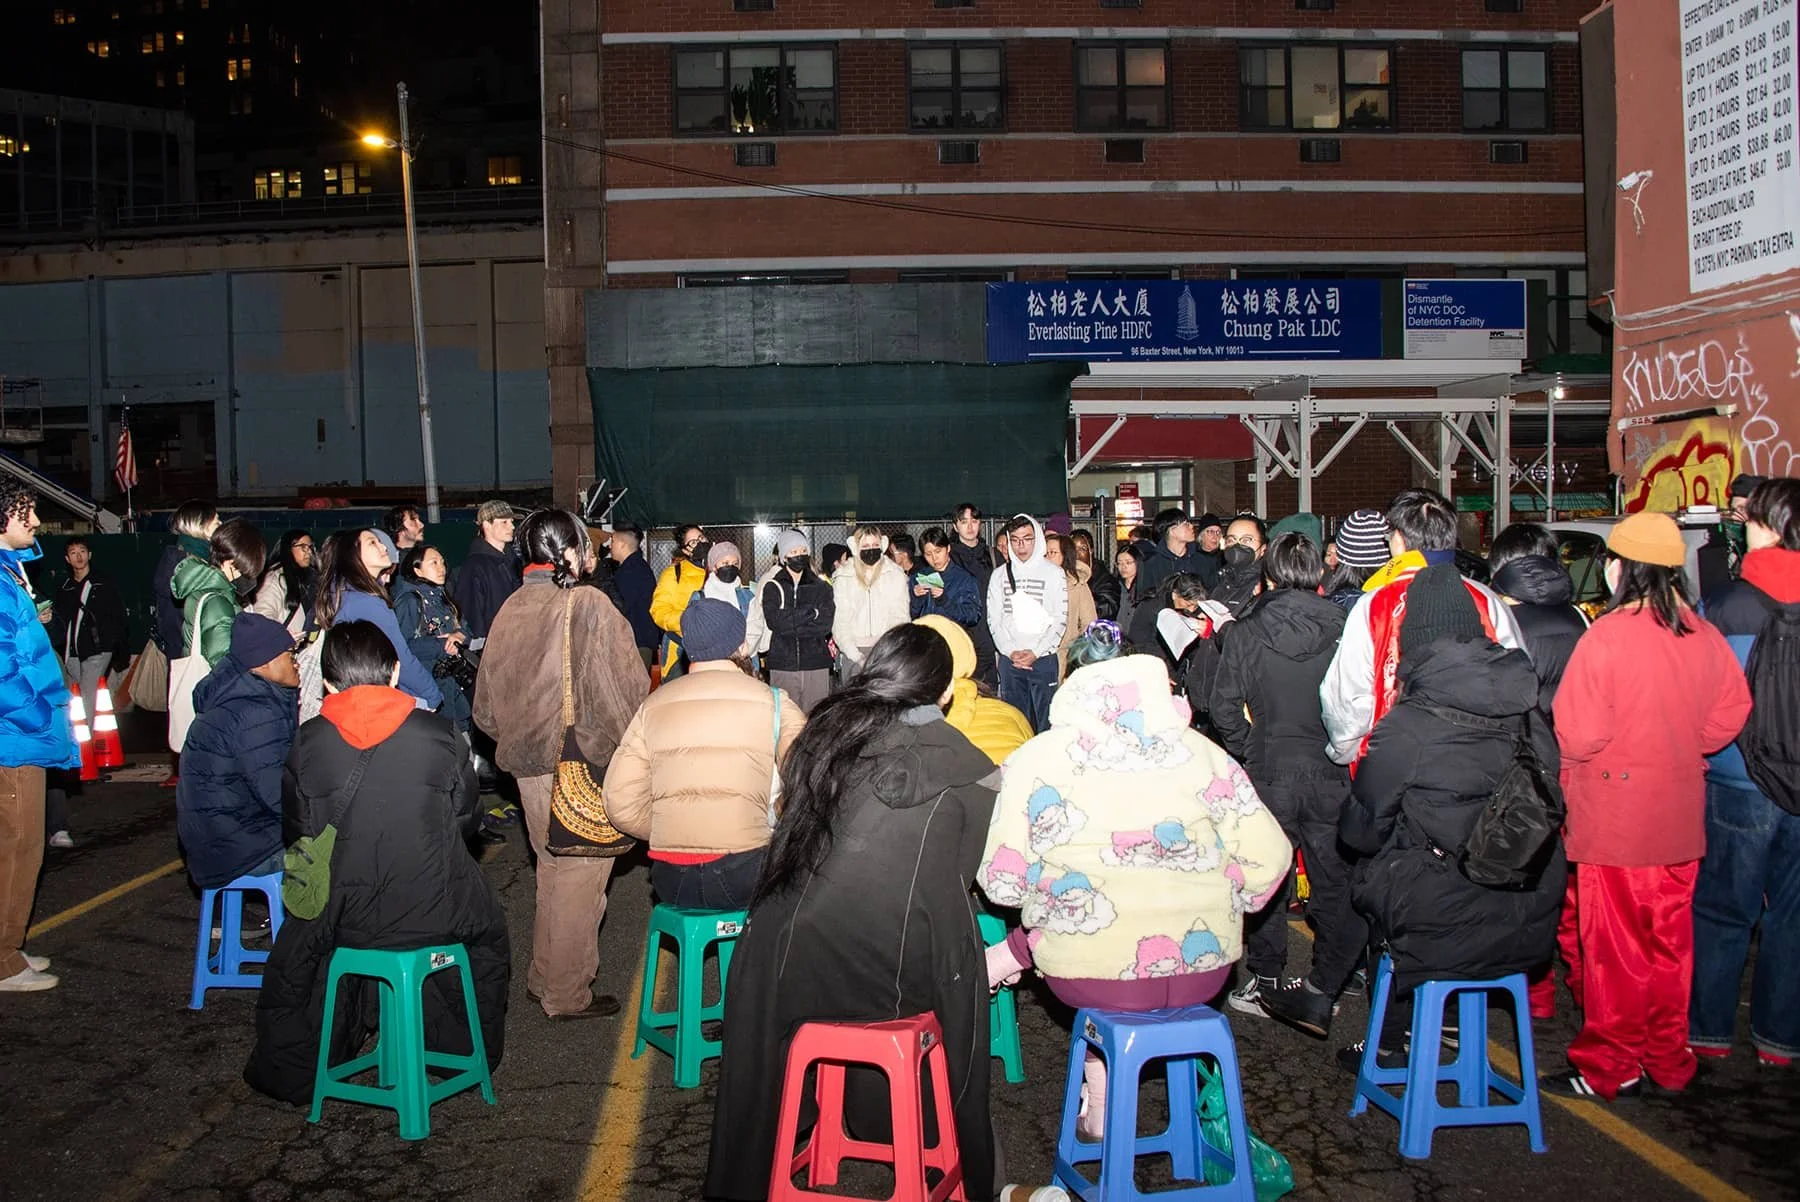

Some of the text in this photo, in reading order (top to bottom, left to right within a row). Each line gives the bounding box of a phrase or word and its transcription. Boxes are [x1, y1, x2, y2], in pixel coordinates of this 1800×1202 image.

[1684, 1, 1714, 28] EFFECTIVE
[1685, 35, 1702, 57] ENTER
[1726, 18, 1734, 34] TO
[1686, 66, 1695, 85] UP
[1697, 62, 1705, 79] TO
[1707, 57, 1715, 74] 1/2
[1716, 45, 1740, 69] HOURS
[1772, 20, 1790, 42] 15.00
[1687, 46, 1790, 108] UP TO 1 HOURS $21.12 25.00
[1688, 72, 1791, 132] UP TO 2 HOURS $27.64 32.00
[1689, 97, 1791, 154] UP TO 3 HOURS $35.49 42.00
[1690, 159, 1699, 178] UP
[1700, 157, 1709, 174] TO
[1711, 153, 1715, 170] 6
[1718, 143, 1741, 166] HOURS
[1774, 123, 1792, 145] 46.00
[1691, 180, 1706, 202] FIESTA
[1707, 176, 1718, 196] DAY
[1719, 172, 1732, 194] FLAT
[1732, 166, 1746, 187] RATE
[1776, 150, 1791, 171] 55.00
[1692, 207, 1707, 227] EACH
[1739, 190, 1755, 210] HOUR
[1693, 233, 1701, 251] OR
[1702, 228, 1715, 246] PART
[1716, 222, 1733, 243] THERE
[1717, 249, 1729, 268] NYC
[1730, 241, 1758, 265] PARKING
[1759, 237, 1772, 257] TAX
[1772, 231, 1794, 255] EXTRA
[1027, 288, 1151, 318] 松柏老人大廈
[1221, 287, 1340, 316] 松柏發展公司
[1408, 294, 1453, 304] Dismantle
[1408, 305, 1465, 315] of NYC DOC
[1028, 321, 1152, 343] Everlasting Pine HDFC
[1223, 319, 1341, 341] Chung Pak LDC
[1408, 317, 1485, 328] Detention Facility
[1131, 346, 1244, 356] 96 Baxter Street, New York, NY 10013
